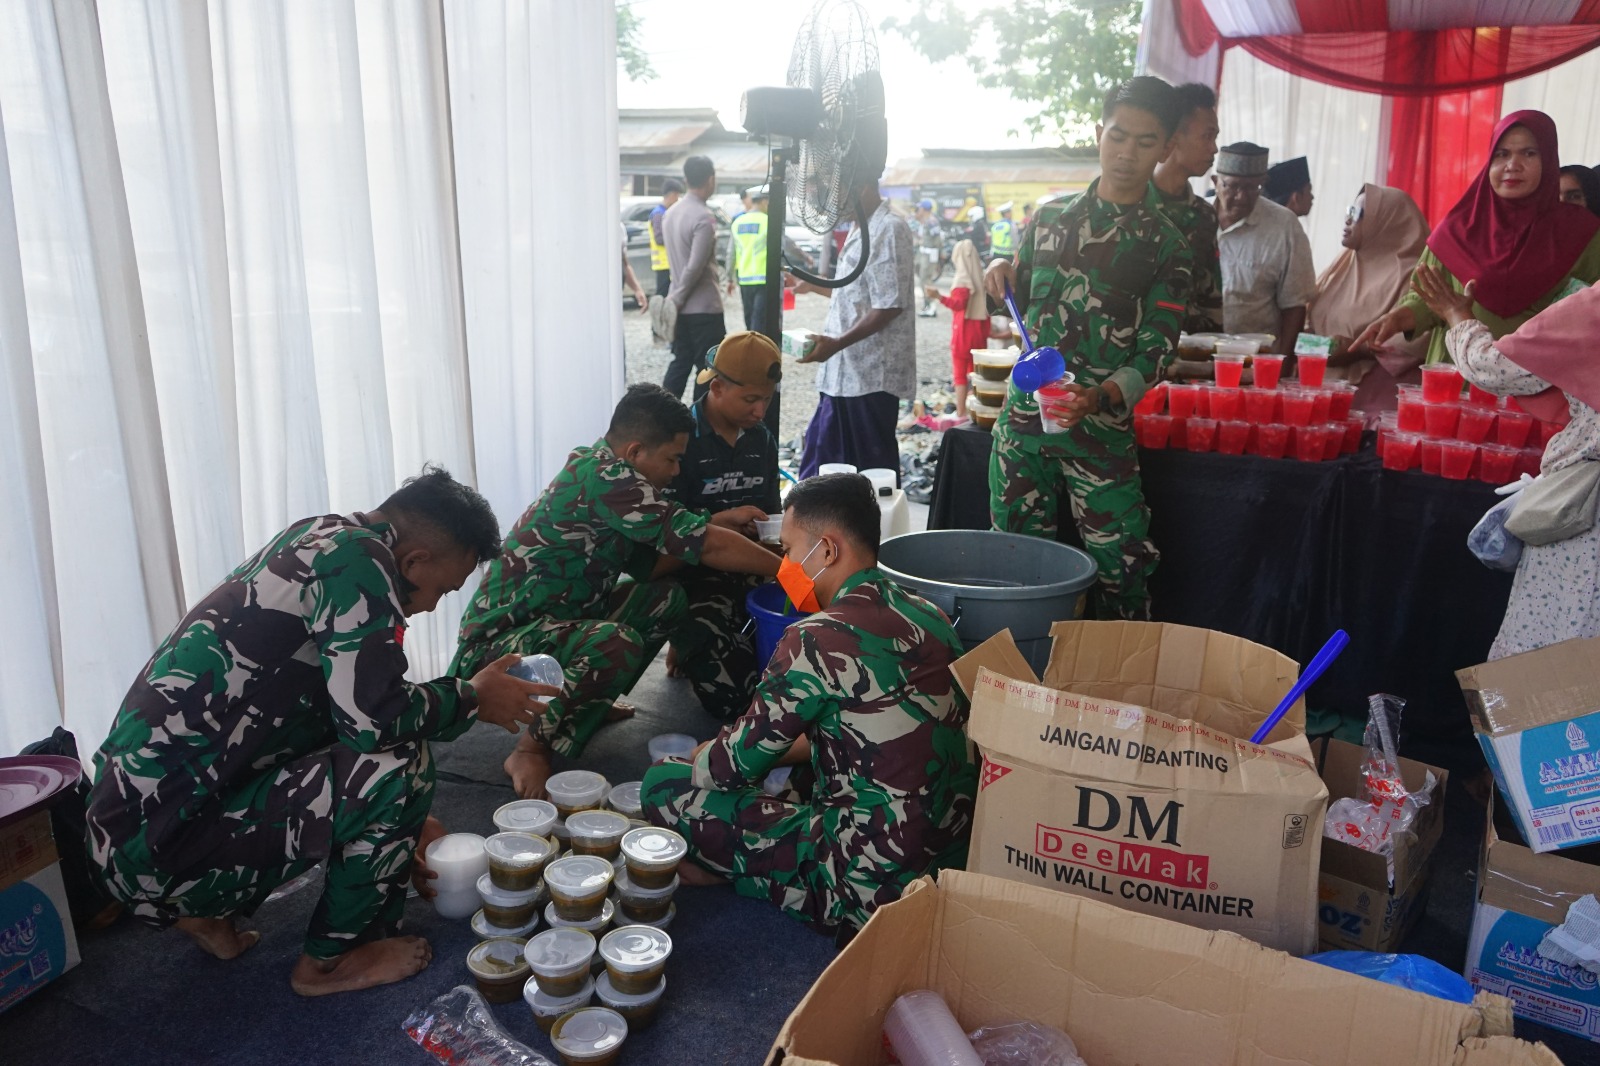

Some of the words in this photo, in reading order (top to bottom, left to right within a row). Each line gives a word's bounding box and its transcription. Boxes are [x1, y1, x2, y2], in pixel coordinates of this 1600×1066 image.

[982, 675, 992, 685] DM
[994, 680, 1005, 690] DM
[1008, 685, 1022, 695] DM
[1045, 694, 1060, 704] DM
[1064, 699, 1079, 708] DM
[1084, 703, 1099, 712] DM
[1104, 707, 1120, 716] DM
[1125, 711, 1140, 720] DM
[1145, 715, 1158, 725] DM
[1162, 720, 1175, 731] DM
[1195, 728, 1210, 738] DM
[1215, 734, 1229, 744] DM
[1039, 725, 1121, 754] JANGAN
[1126, 740, 1229, 773] DIBANTING
[1072, 785, 1184, 848] DM
[1004, 845, 1047, 878] THIN
[1053, 864, 1114, 895] WALL
[1120, 880, 1254, 918] CONTAINER
[1042, 830, 1203, 884] DeeMak
